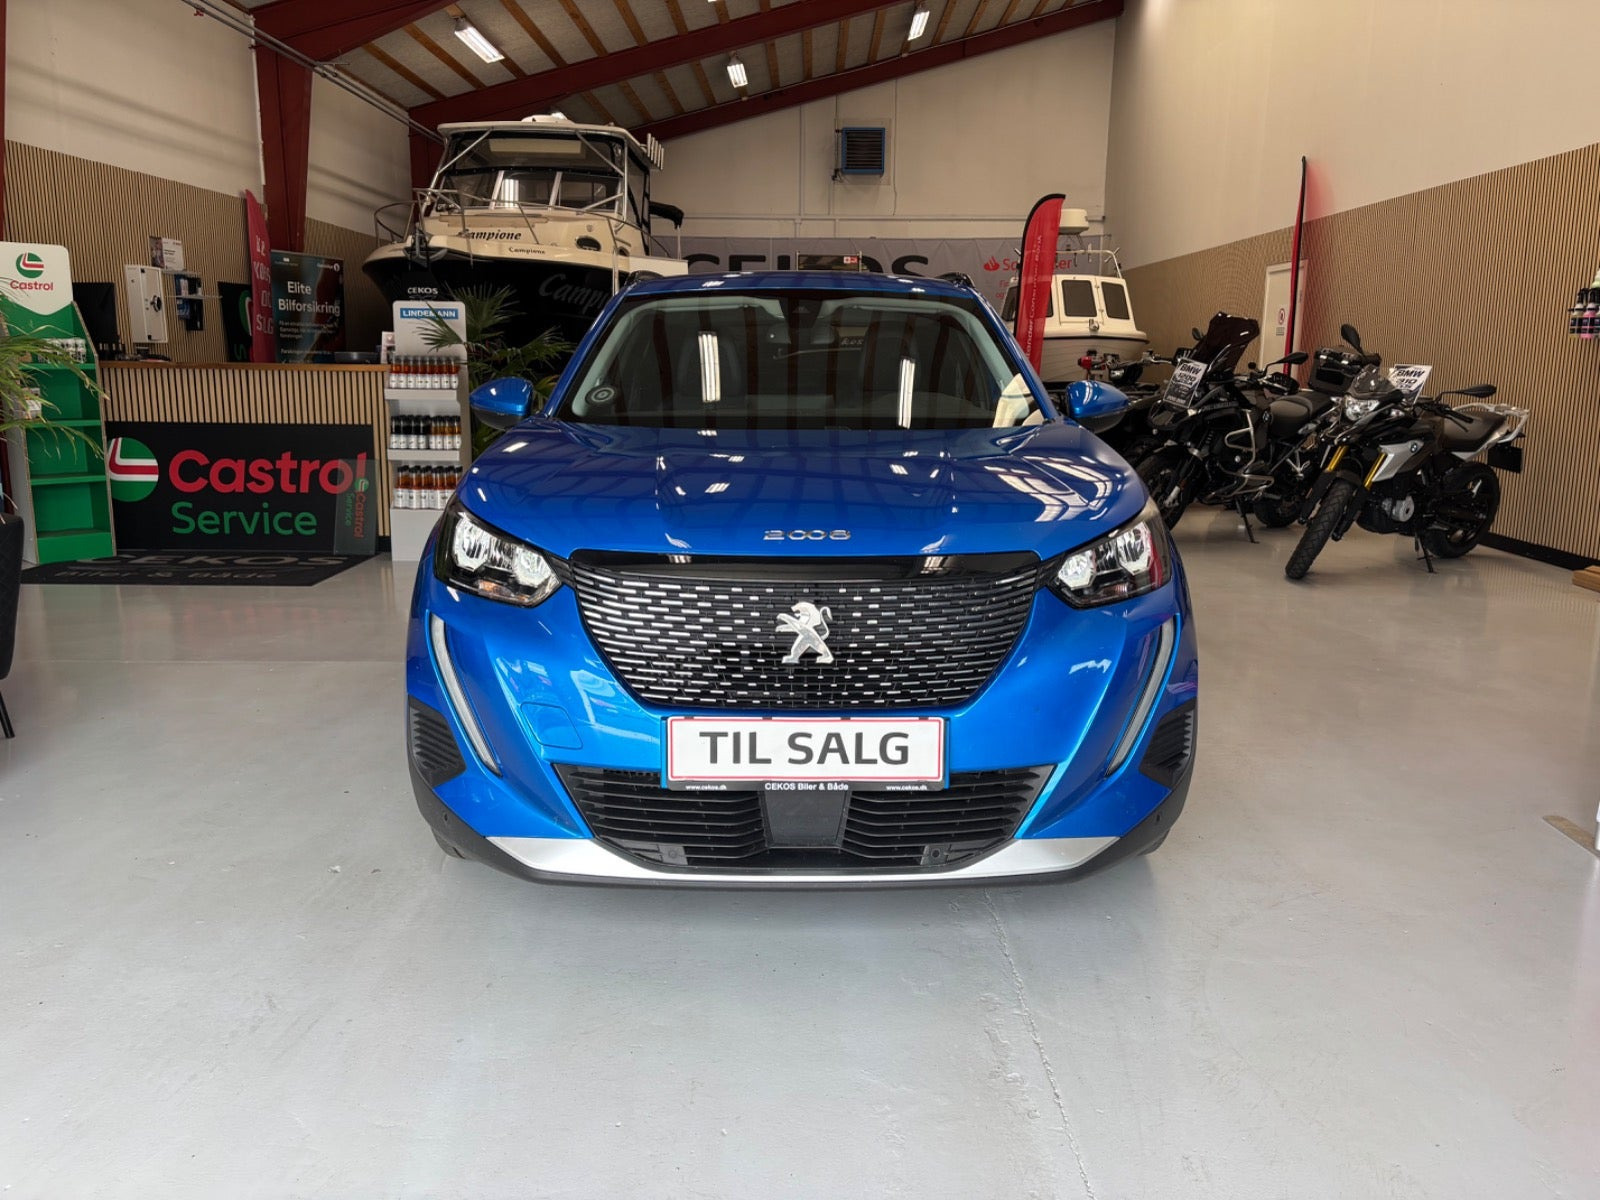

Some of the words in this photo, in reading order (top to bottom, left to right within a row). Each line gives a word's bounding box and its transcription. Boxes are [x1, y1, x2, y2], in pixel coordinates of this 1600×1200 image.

[9, 279, 54, 291] Castrol
[287, 280, 313, 295] Elite
[407, 286, 439, 295] CEKOS
[278, 298, 341, 317] Bilforsikring
[1180, 363, 1202, 375] BMW
[1396, 369, 1425, 378] BMW
[168, 449, 368, 494] Castrol
[171, 502, 318, 536] Service
[353, 491, 367, 539] Castrol
[763, 529, 851, 541] 2008
[698, 731, 772, 765] TIL
[787, 731, 910, 766] SALG
[764, 782, 796, 791] CEKOS
[797, 782, 817, 791] Biler
[818, 782, 826, 791] &
[826, 781, 849, 791] Både
